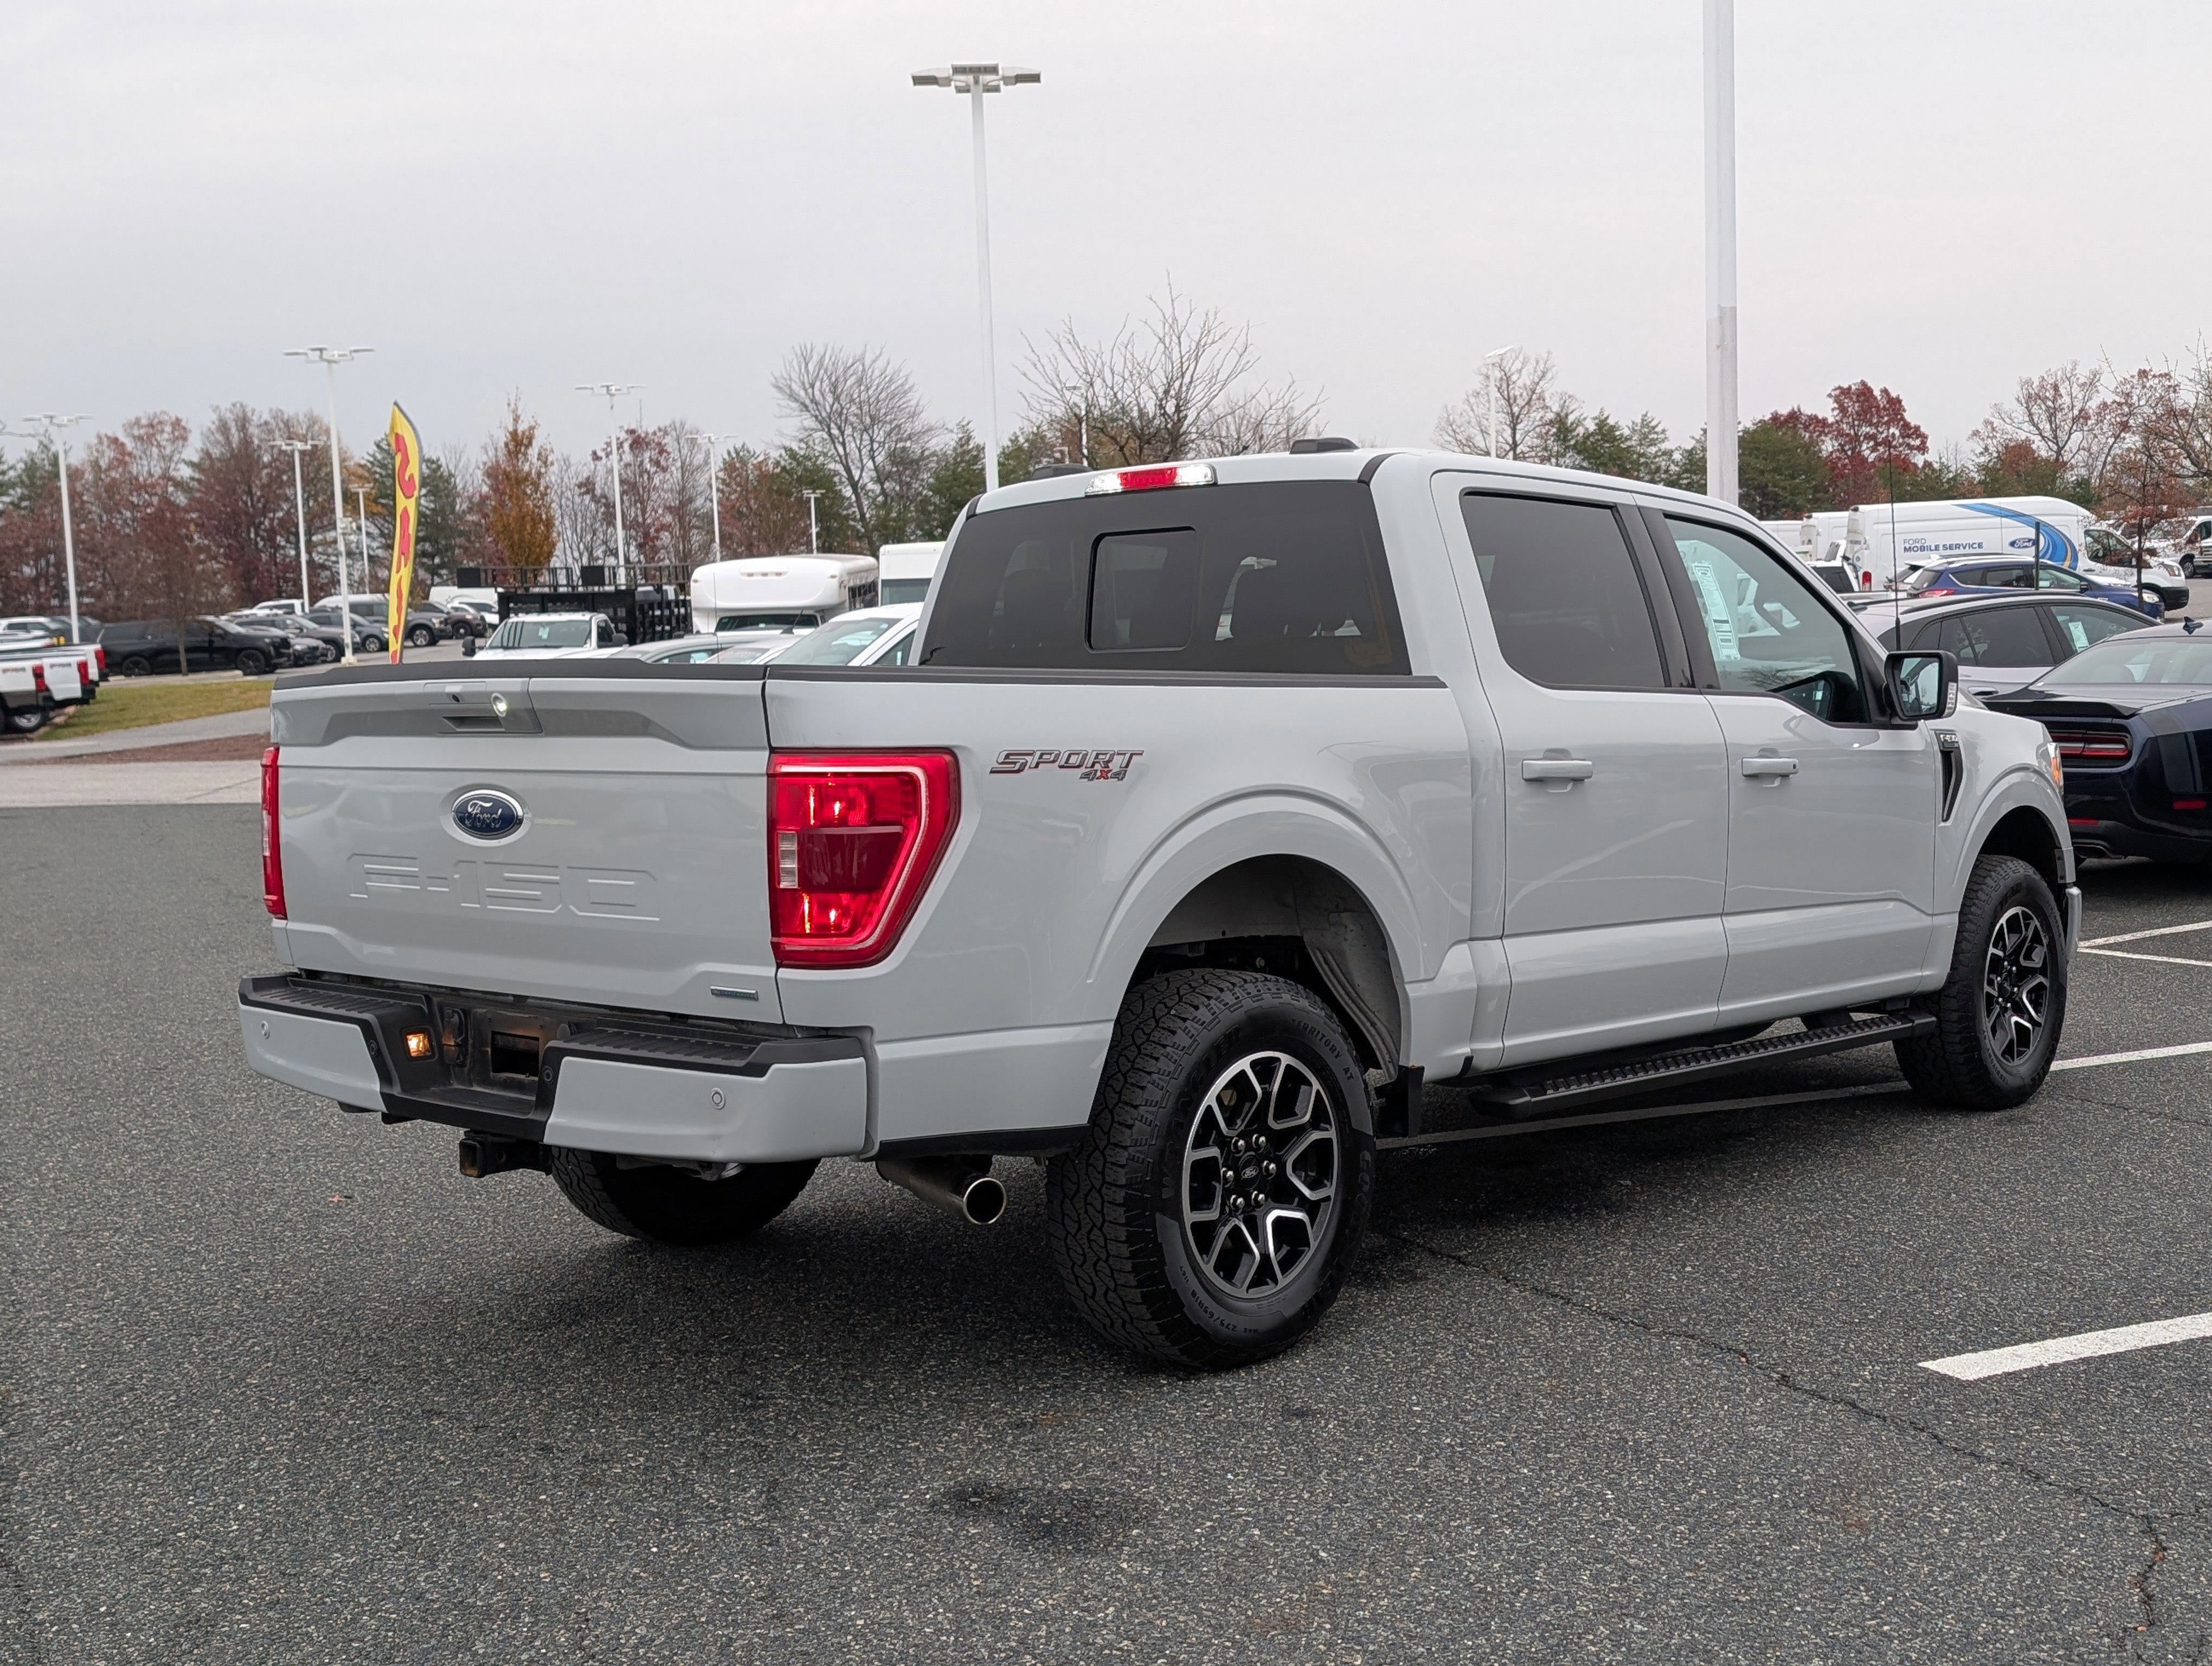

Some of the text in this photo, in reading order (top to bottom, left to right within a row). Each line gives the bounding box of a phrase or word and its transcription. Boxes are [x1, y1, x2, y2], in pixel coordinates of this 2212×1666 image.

[1903, 537, 1927, 546] FORD
[1903, 541, 1984, 553] MOBILE SERVICE
[989, 749, 1144, 775] SPORT
[1078, 768, 1128, 781] 4x4
[346, 853, 660, 921] F-150
